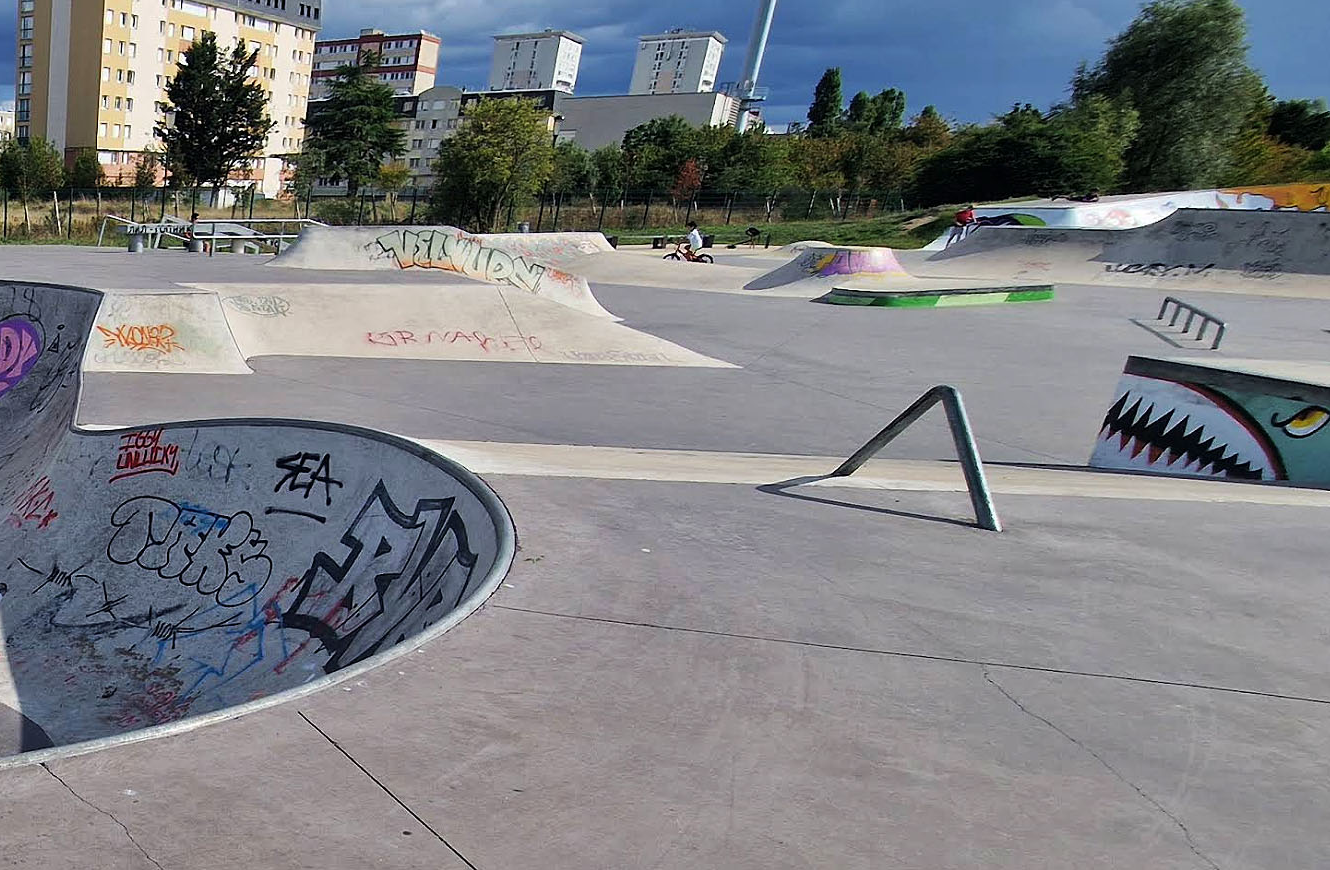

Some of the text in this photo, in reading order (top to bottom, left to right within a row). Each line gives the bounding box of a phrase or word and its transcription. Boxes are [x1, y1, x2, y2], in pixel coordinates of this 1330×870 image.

[120, 428, 164, 450] IGGY
[116, 444, 179, 471] UNLUCKY
[274, 451, 344, 506] SEA
